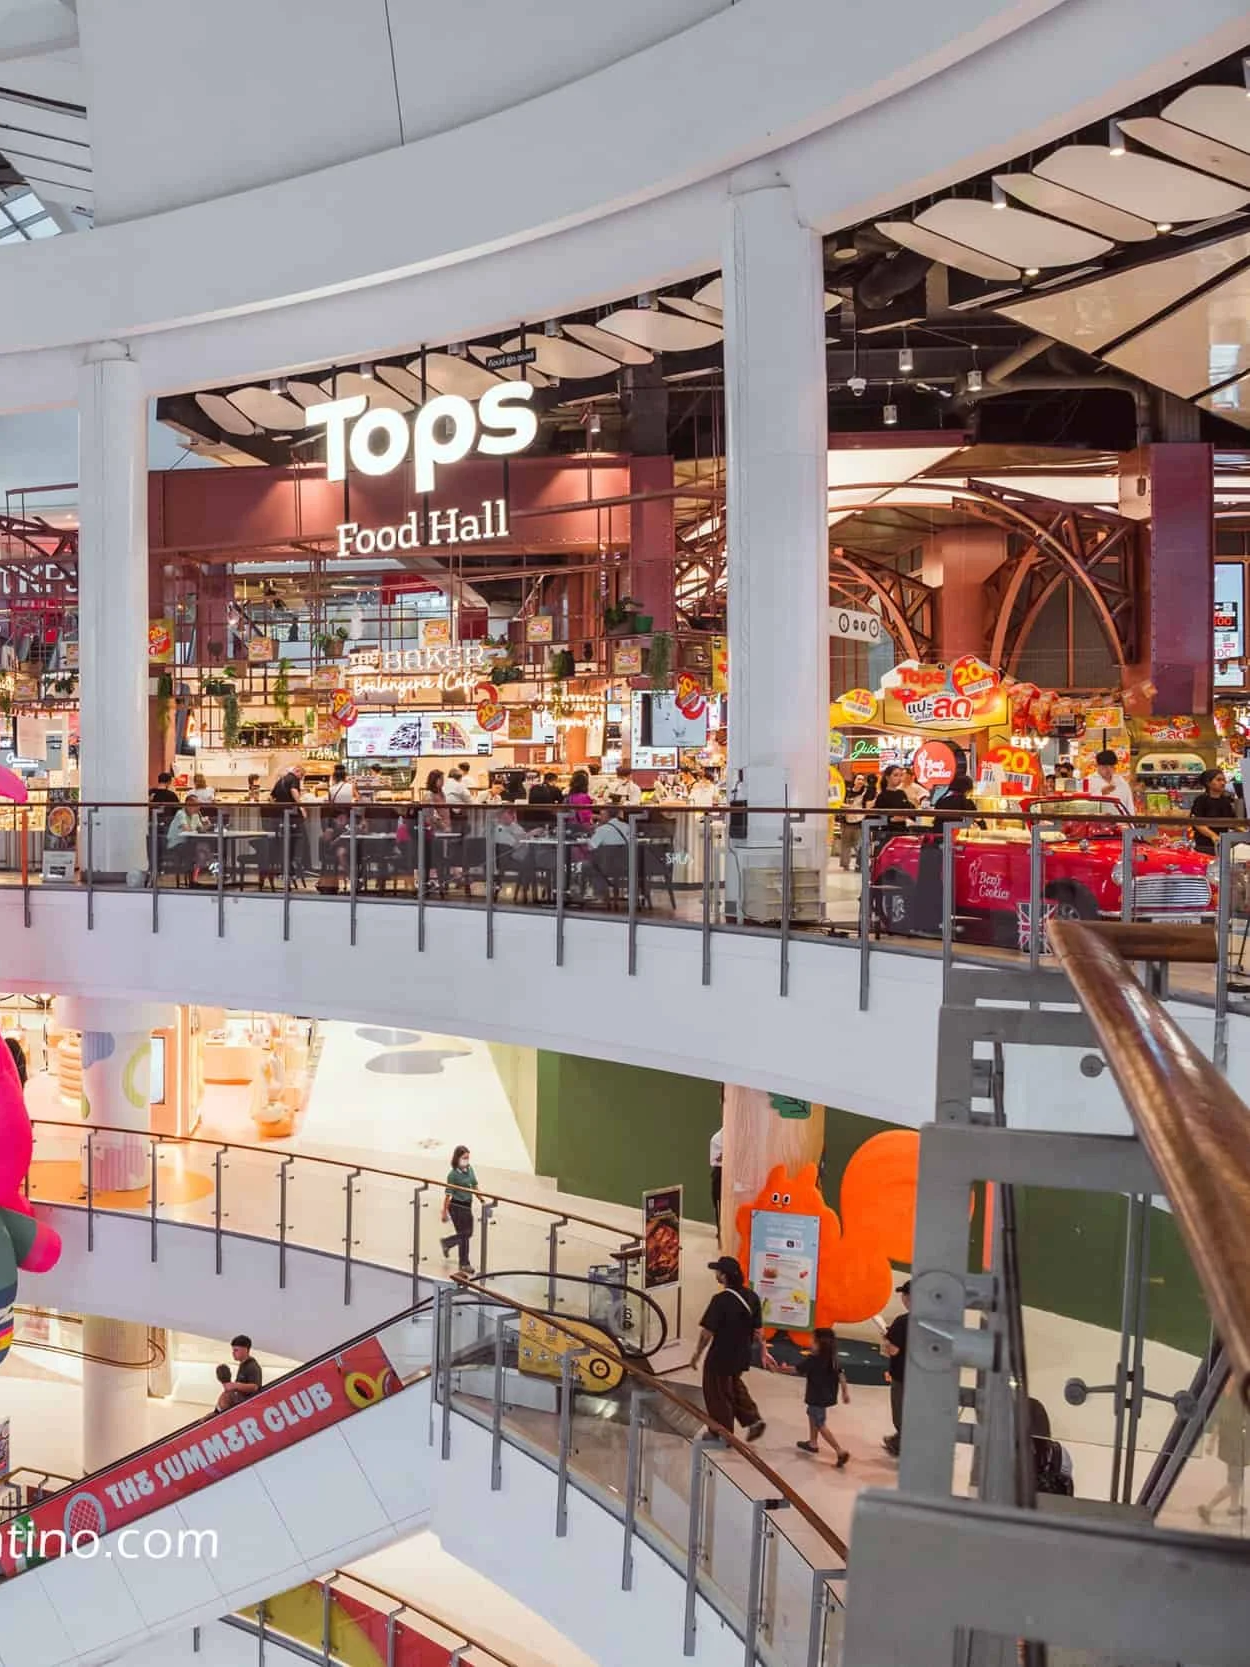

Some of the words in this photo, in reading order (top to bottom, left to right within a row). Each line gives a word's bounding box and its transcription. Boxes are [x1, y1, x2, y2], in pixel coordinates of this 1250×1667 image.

[306, 380, 537, 494] Tops
[336, 512, 419, 557] Food
[429, 499, 509, 545] Hall
[897, 667, 946, 688] Tops
[105, 1470, 155, 1509] THE
[154, 1417, 266, 1488] SUMMER
[262, 1382, 333, 1433] CLUB
